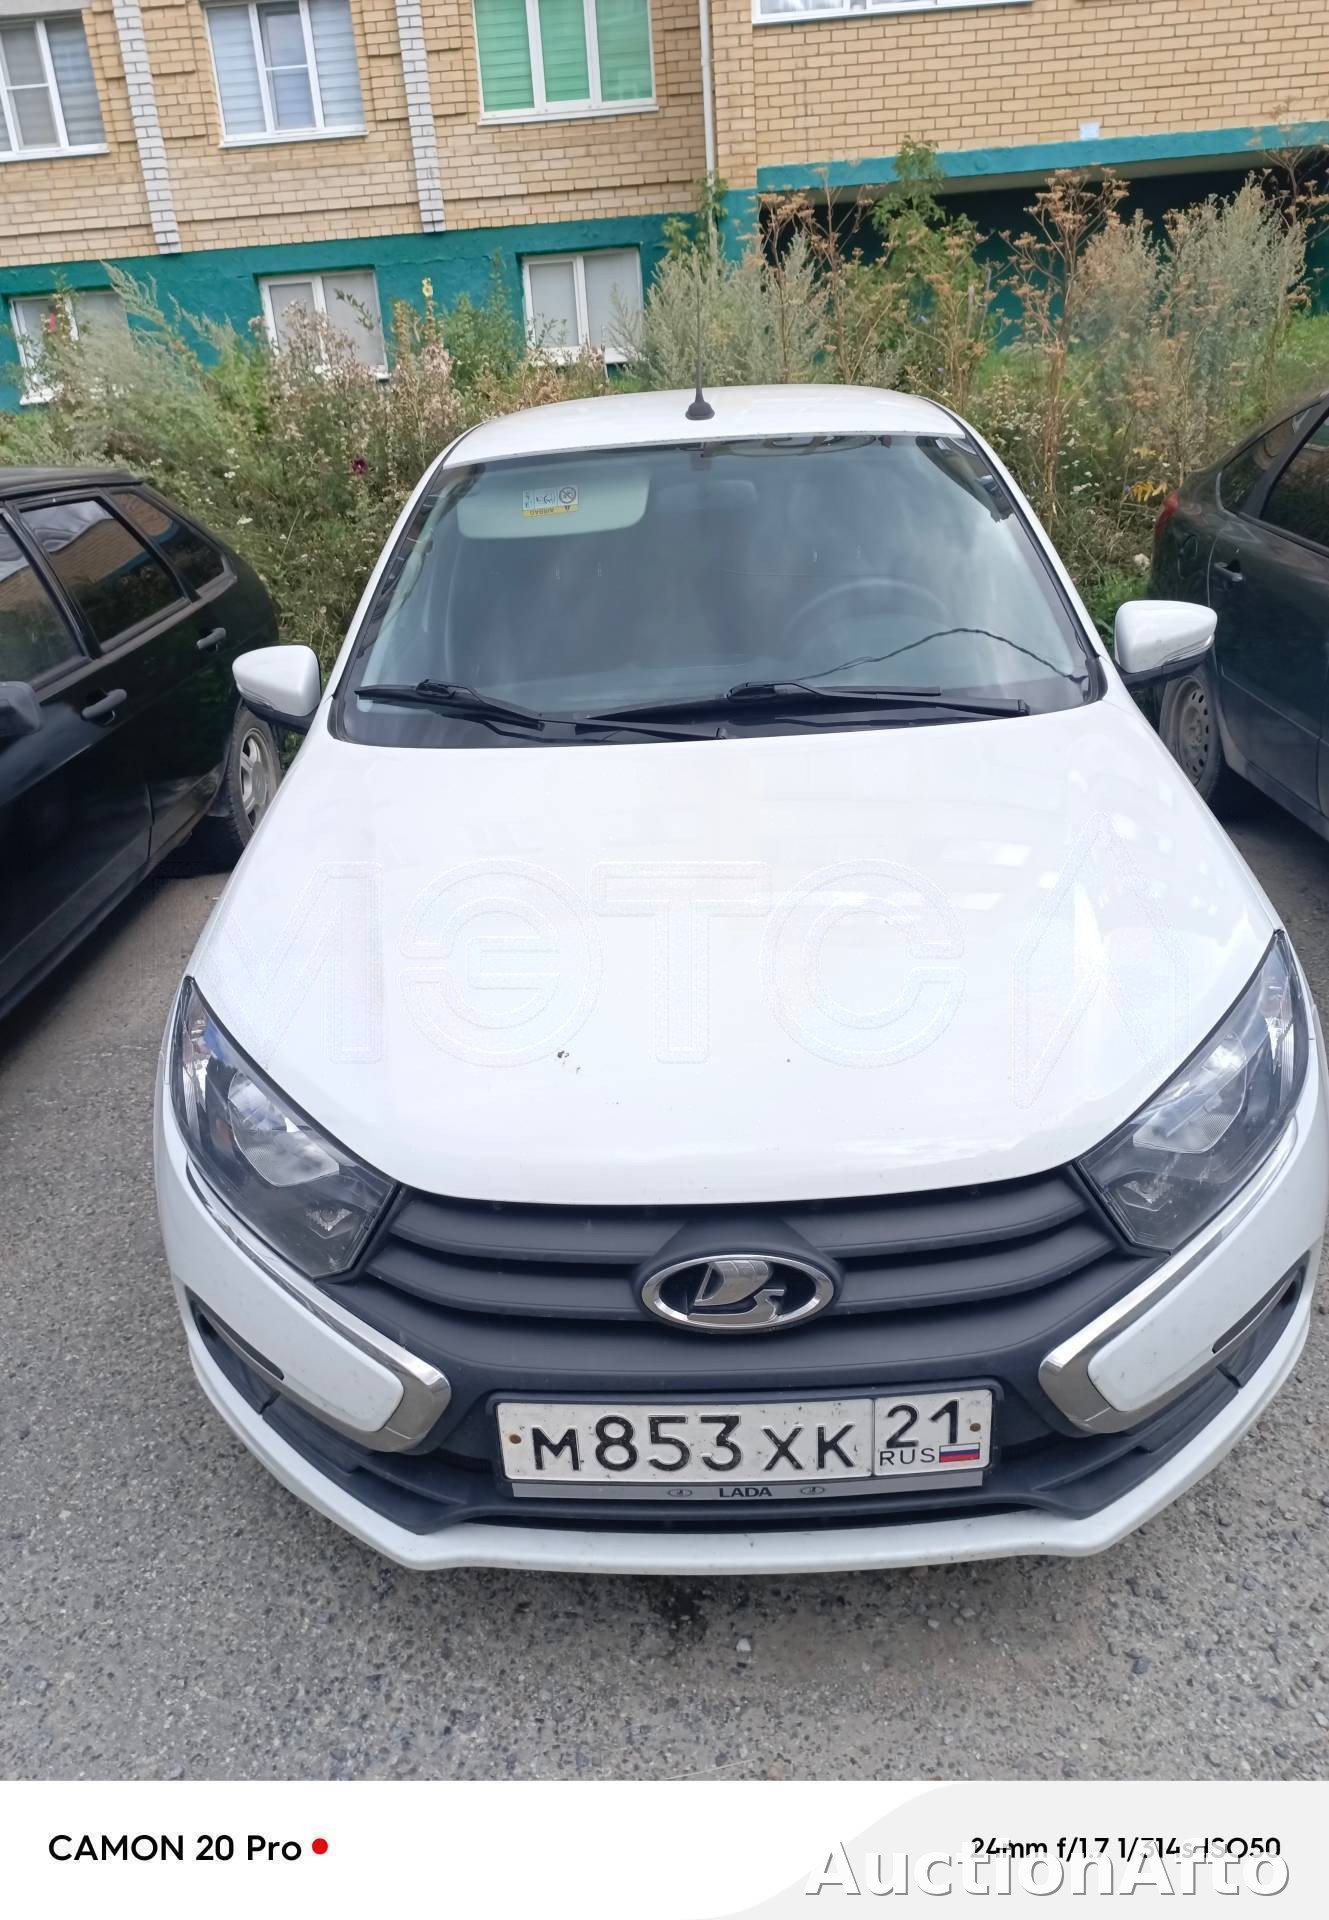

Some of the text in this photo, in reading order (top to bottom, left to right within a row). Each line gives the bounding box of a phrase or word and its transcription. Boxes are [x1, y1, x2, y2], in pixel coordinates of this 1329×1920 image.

[886, 1399, 959, 1449] 21
[879, 1447, 936, 1467] RUS
[719, 1487, 773, 1498] LADA
